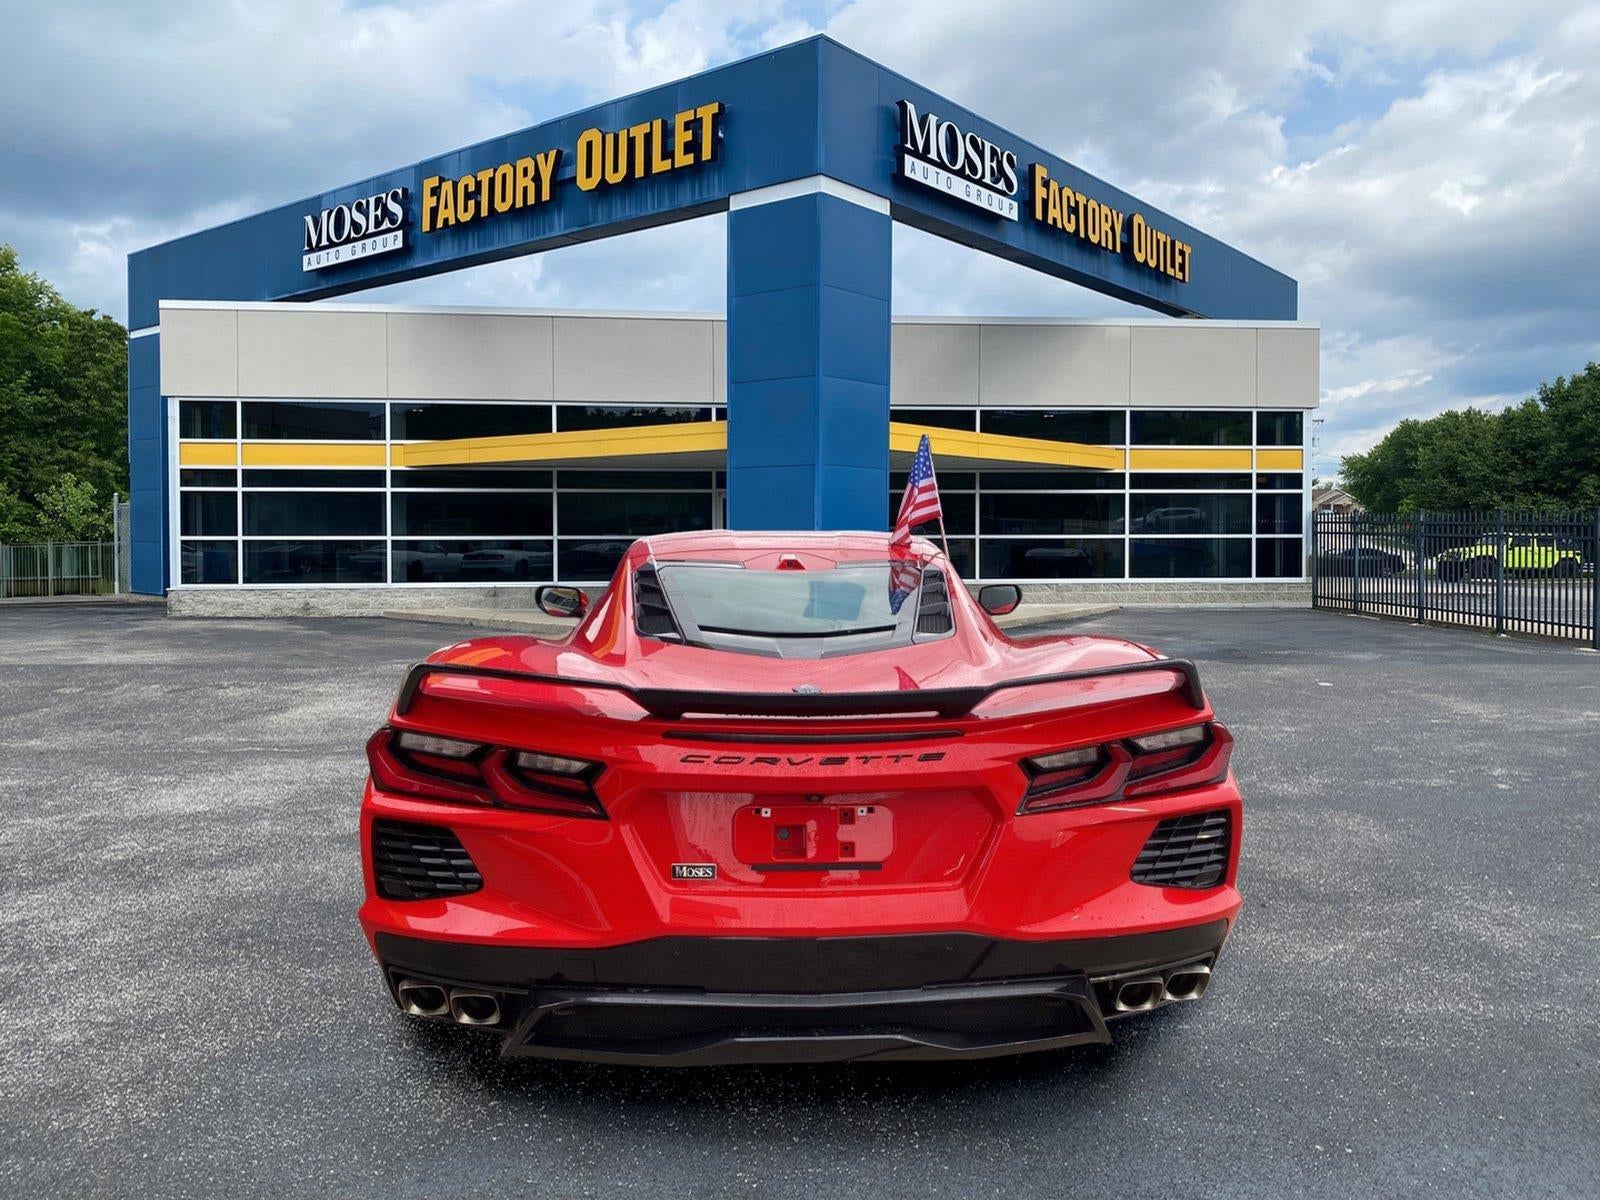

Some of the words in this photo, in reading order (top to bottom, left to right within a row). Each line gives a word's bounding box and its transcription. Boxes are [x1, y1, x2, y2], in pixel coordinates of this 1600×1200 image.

[421, 148, 561, 234] FACTORY
[575, 101, 720, 192] OUTLET
[903, 99, 1019, 196] MOSES
[303, 187, 404, 252] MOSES
[910, 160, 953, 190] AUTO
[965, 184, 1015, 215] GROUP
[307, 248, 341, 268] AUTO
[350, 233, 399, 257] GROUP
[1033, 163, 1124, 253] FACTORY
[1132, 212, 1192, 283] OUTLET
[680, 752, 946, 766] CORVETTE
